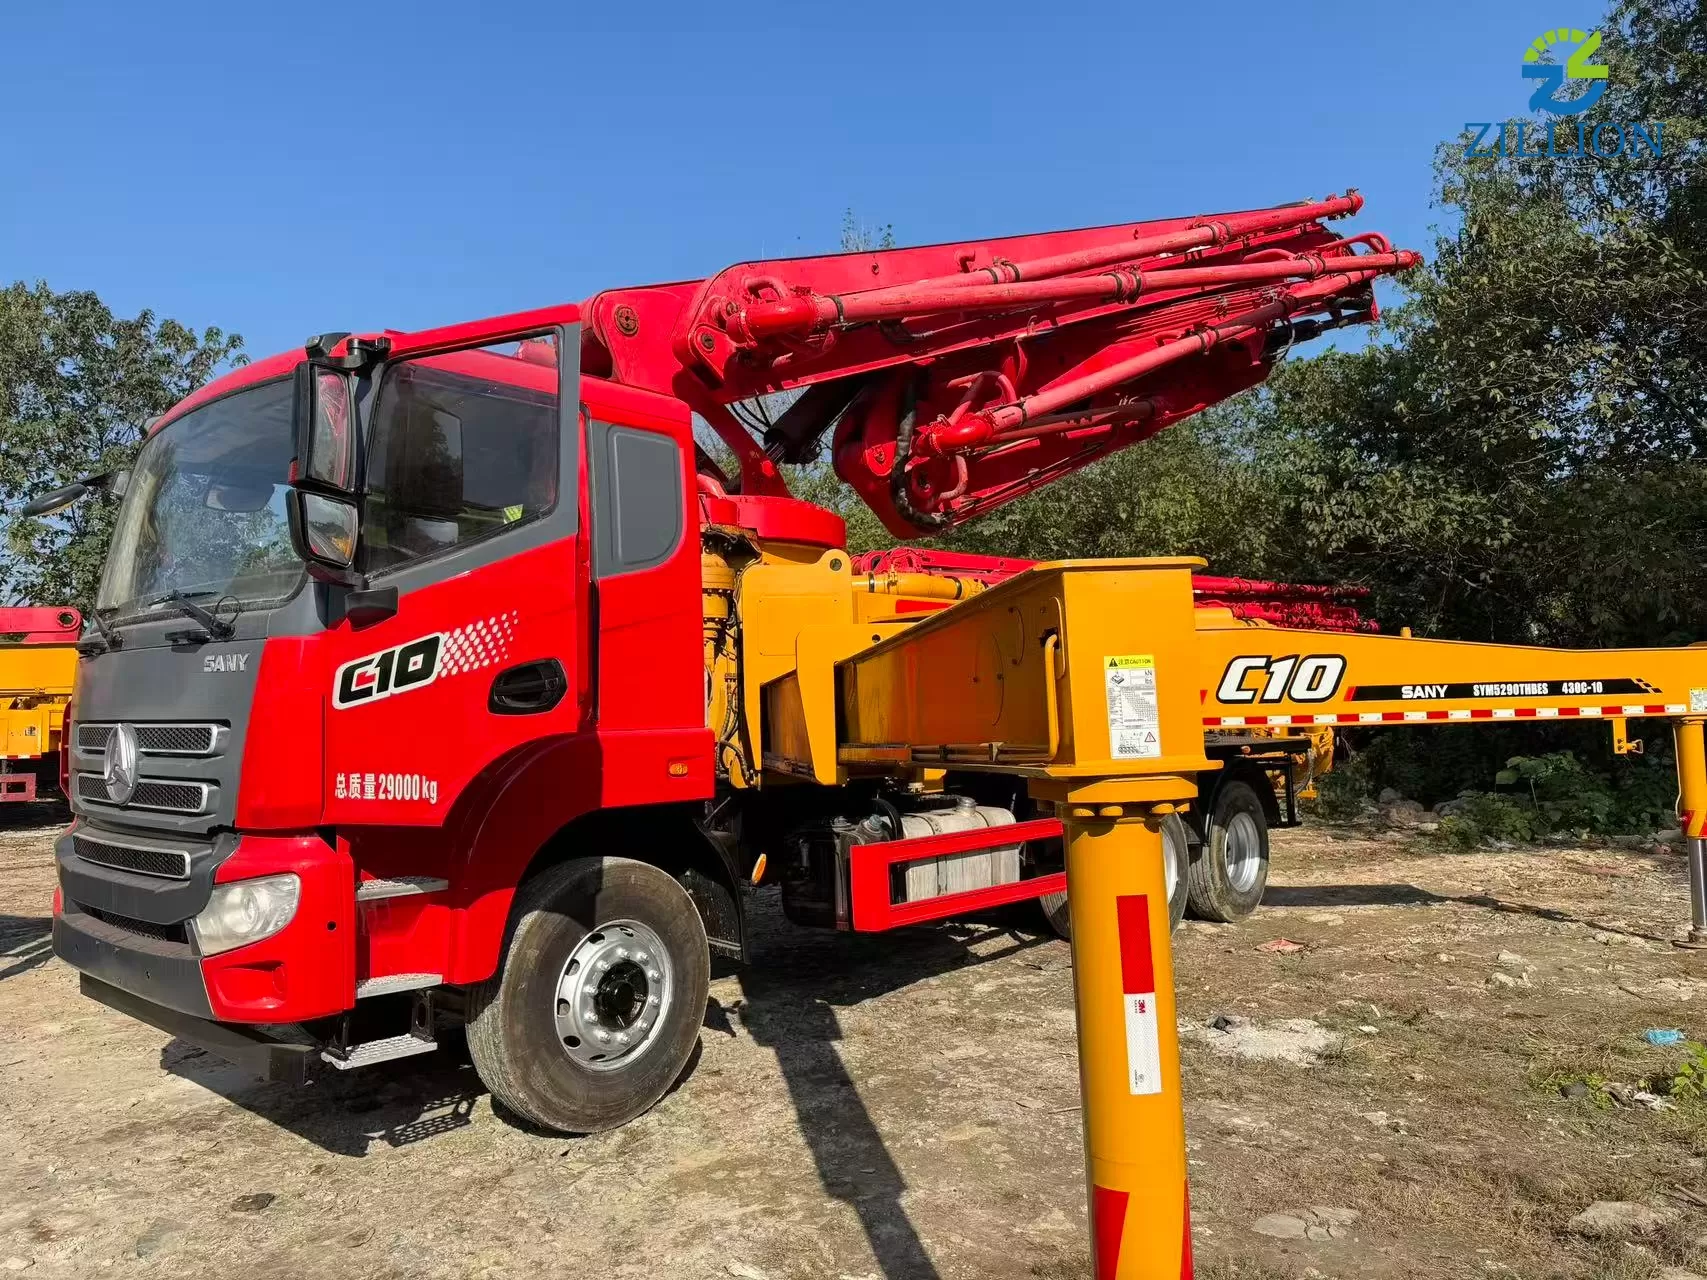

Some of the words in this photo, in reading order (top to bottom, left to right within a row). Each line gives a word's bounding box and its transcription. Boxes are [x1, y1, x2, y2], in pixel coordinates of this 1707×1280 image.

[203, 653, 250, 672] SANY
[335, 633, 444, 707] C10
[1216, 654, 1347, 704] C10
[1401, 684, 1448, 699] SANY
[1473, 681, 1549, 697] SYM5290THBES
[1561, 681, 1603, 694] 430C-10
[1138, 999, 1146, 1014] 3M
